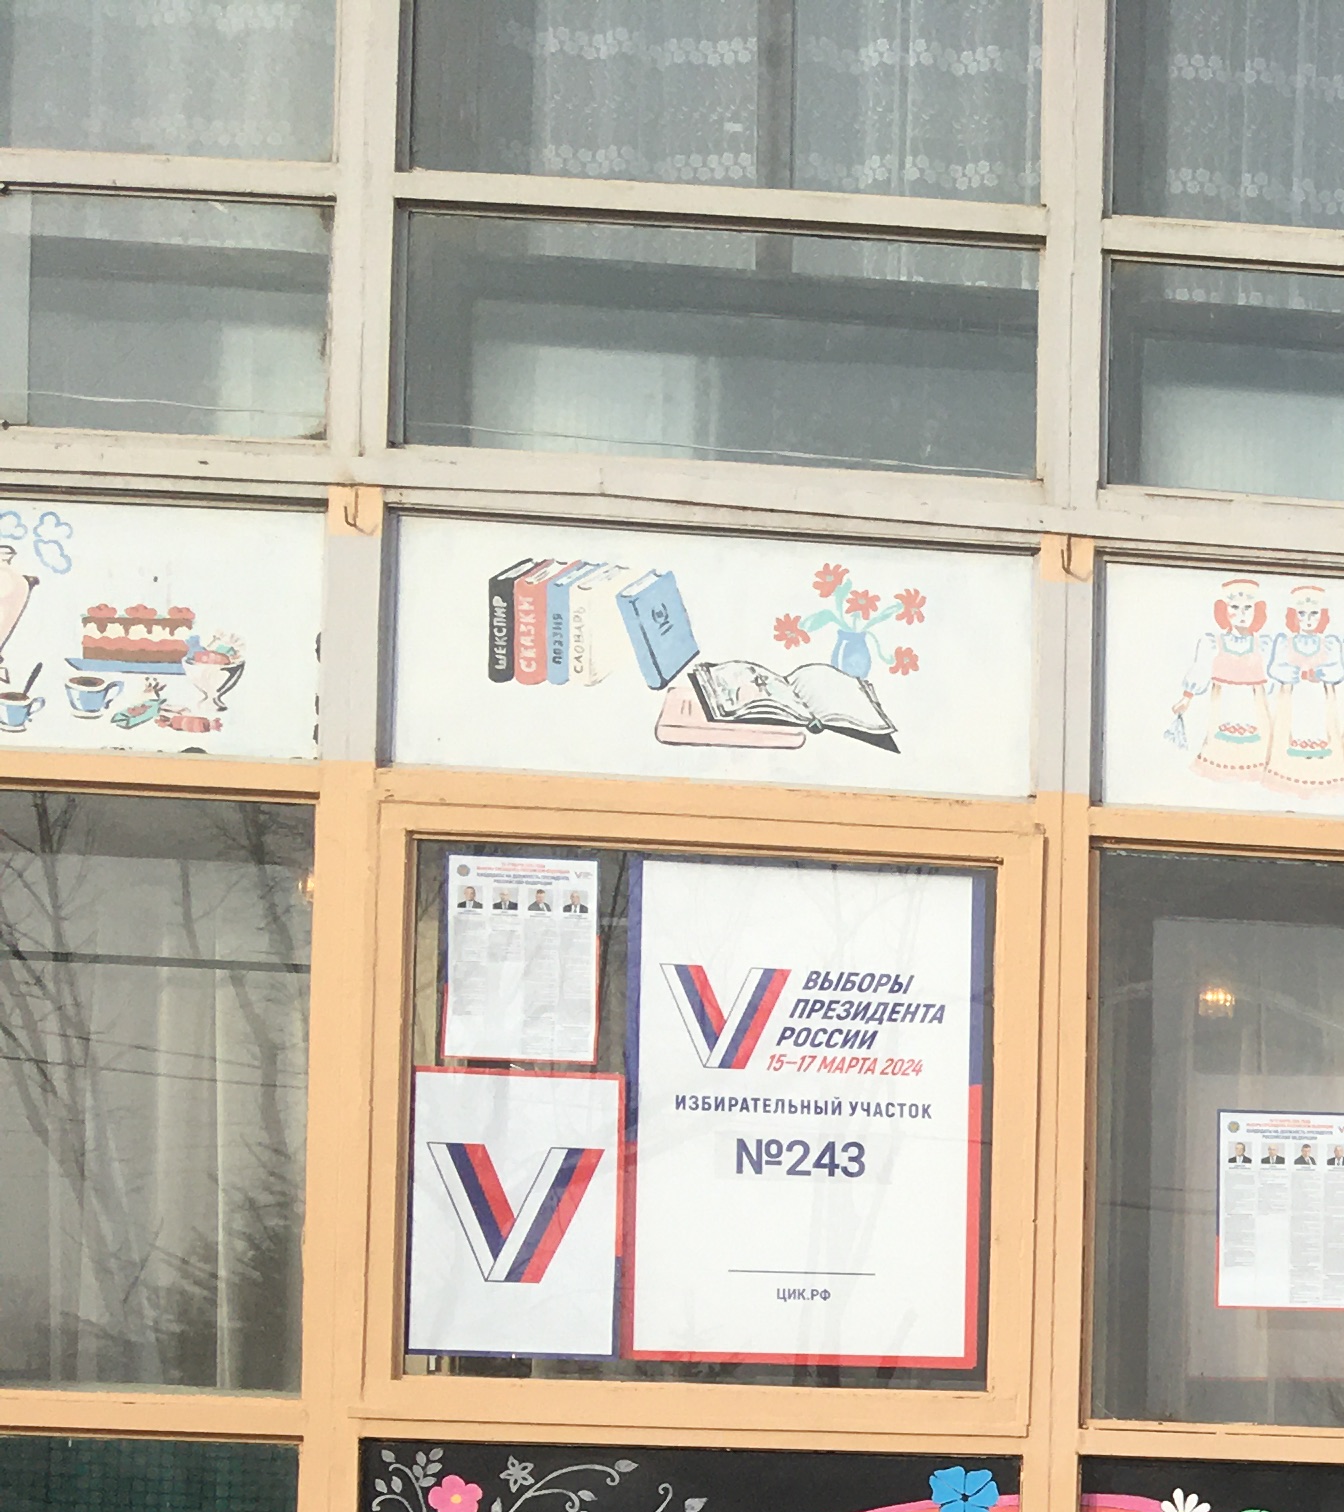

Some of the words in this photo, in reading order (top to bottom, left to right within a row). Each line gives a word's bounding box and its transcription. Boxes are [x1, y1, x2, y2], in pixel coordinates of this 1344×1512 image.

[492, 595, 508, 670] ШЕКСПИР
[518, 595, 537, 673] СКАЗКИ
[573, 606, 586, 674] СЛОВАРЬ
[802, 970, 915, 995] ВЫБОРЫ
[789, 998, 946, 1025] ПРЕЗИДЕНТА
[776, 1026, 879, 1050] РОССИИ
[816, 1056, 878, 1075] МАРТА
[879, 1058, 924, 1077] 2024
[674, 1094, 843, 1116] ИЗБИРАТЕЛЬНЫЙ
[848, 1101, 933, 1119] УЧАСТОК
[735, 1138, 866, 1178] №243
[776, 1288, 831, 1302] ЦИК.РФ
